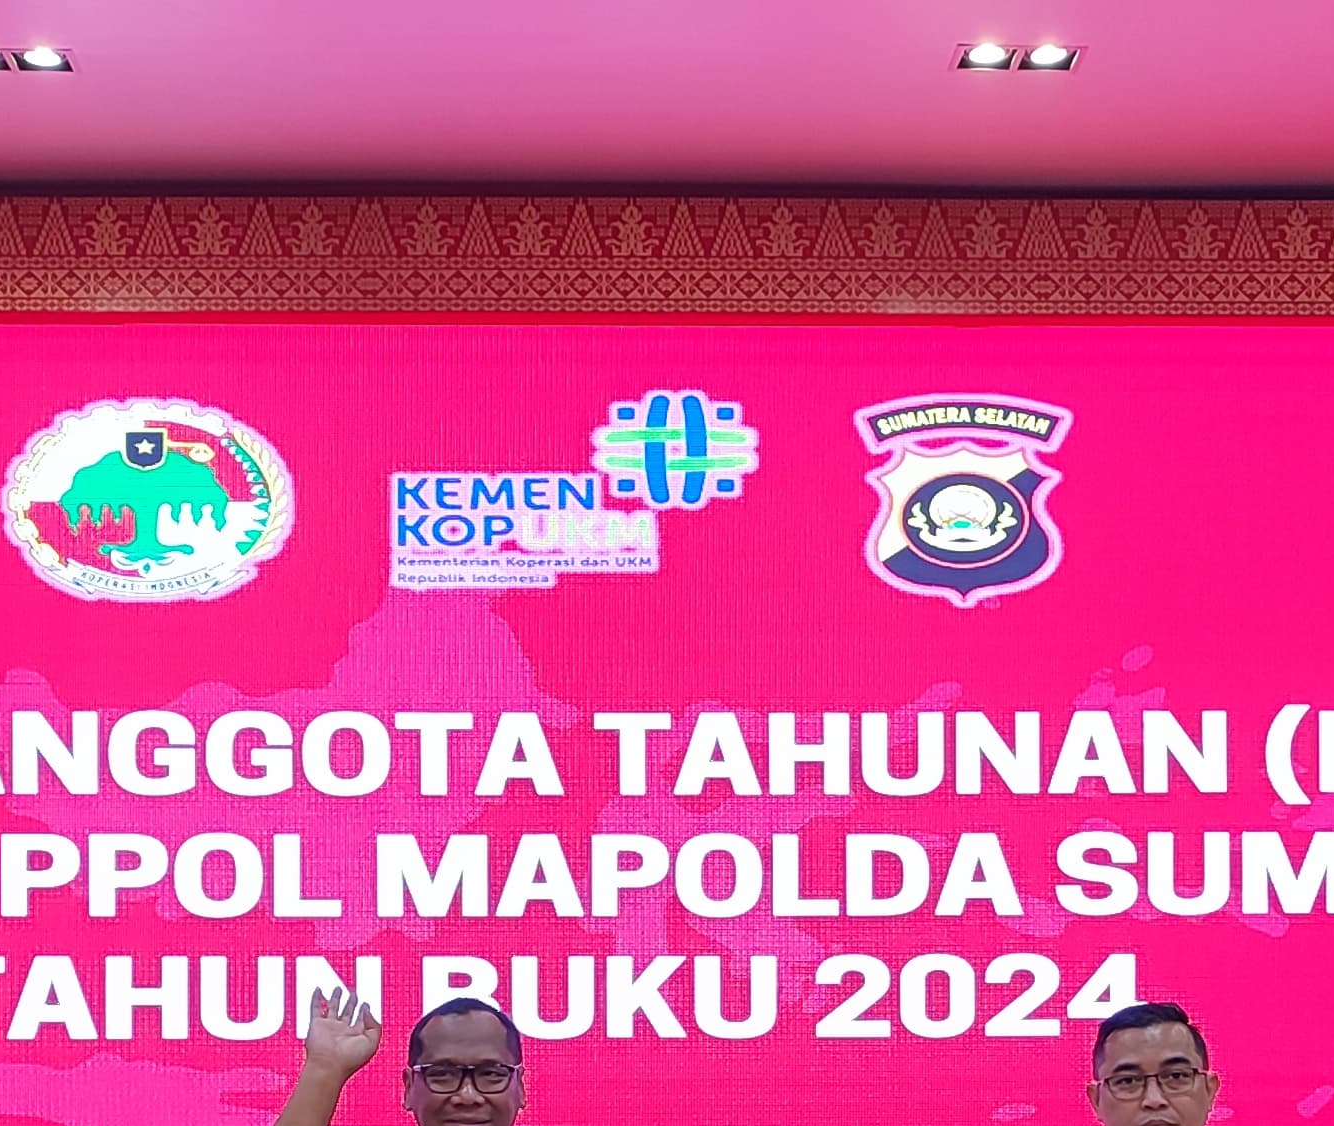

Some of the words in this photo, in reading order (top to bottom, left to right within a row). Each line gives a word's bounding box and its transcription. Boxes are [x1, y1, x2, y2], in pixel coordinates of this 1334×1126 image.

[876, 406, 971, 436] SUMATERA
[974, 406, 1051, 435] SELATAN
[397, 477, 595, 511] KEMEN
[397, 556, 501, 568] Kementerian
[505, 556, 575, 570] Koperasi
[580, 556, 610, 568] dan
[615, 556, 653, 568] UKM
[397, 572, 466, 585] Republik
[471, 572, 550, 584] Indonesia
[593, 710, 1228, 797] TAHUNAN
[376, 832, 1025, 918] MAPOLDA
[422, 955, 778, 1040] BUKU
[815, 952, 1148, 1039] 2024
